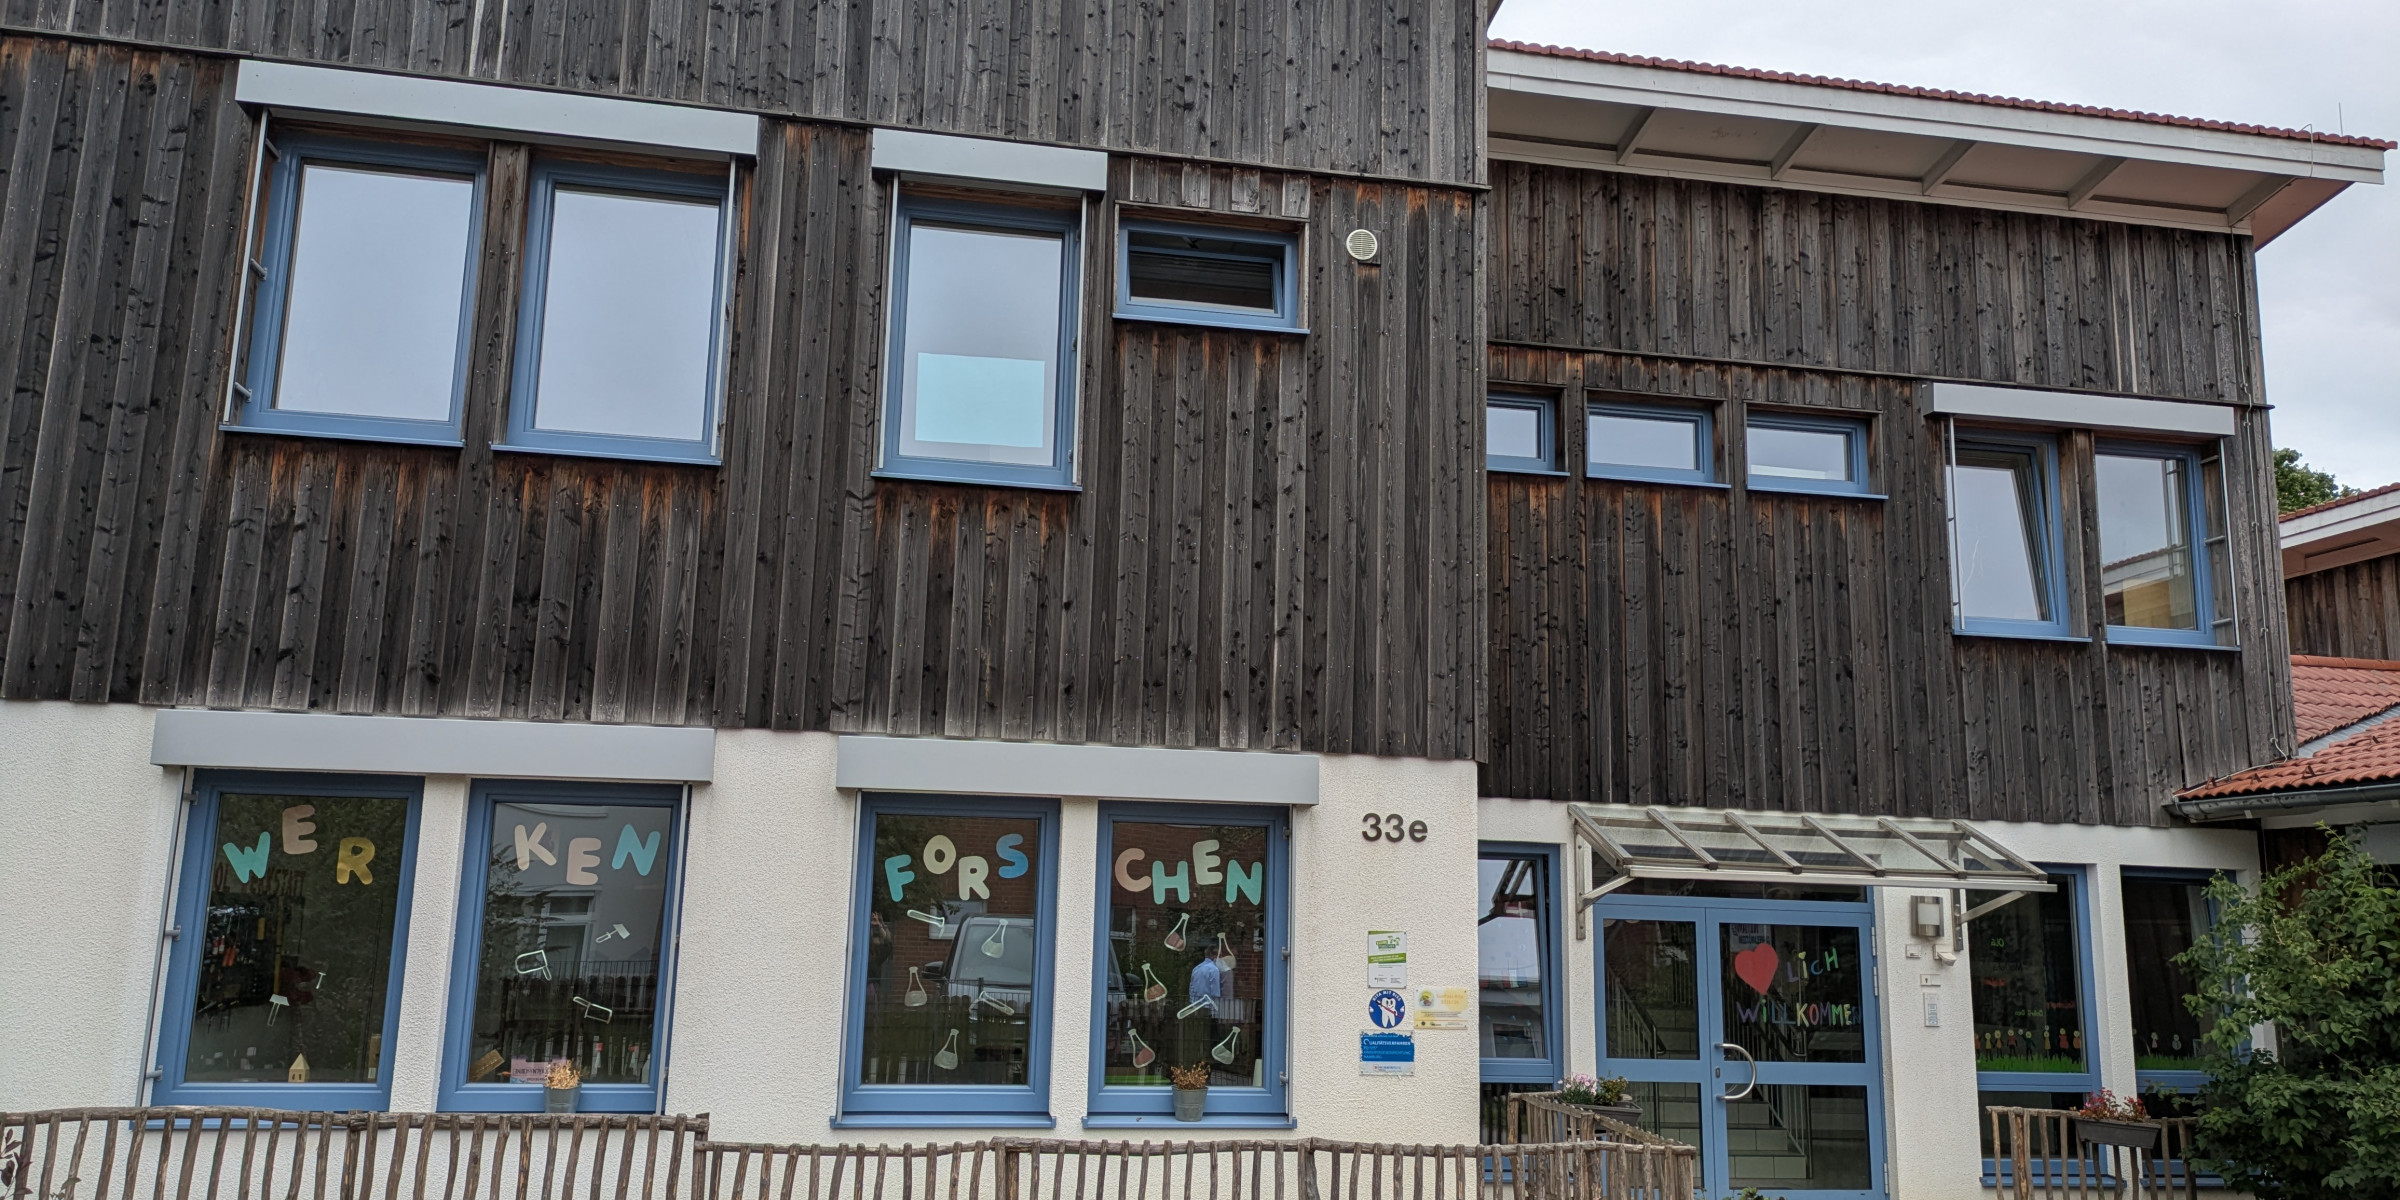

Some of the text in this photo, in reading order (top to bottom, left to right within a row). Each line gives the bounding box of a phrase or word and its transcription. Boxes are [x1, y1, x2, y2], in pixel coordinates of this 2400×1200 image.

[222, 804, 661, 886] WER KEN
[1361, 812, 1429, 843] 33e
[884, 833, 1263, 906] FORS CHEN
